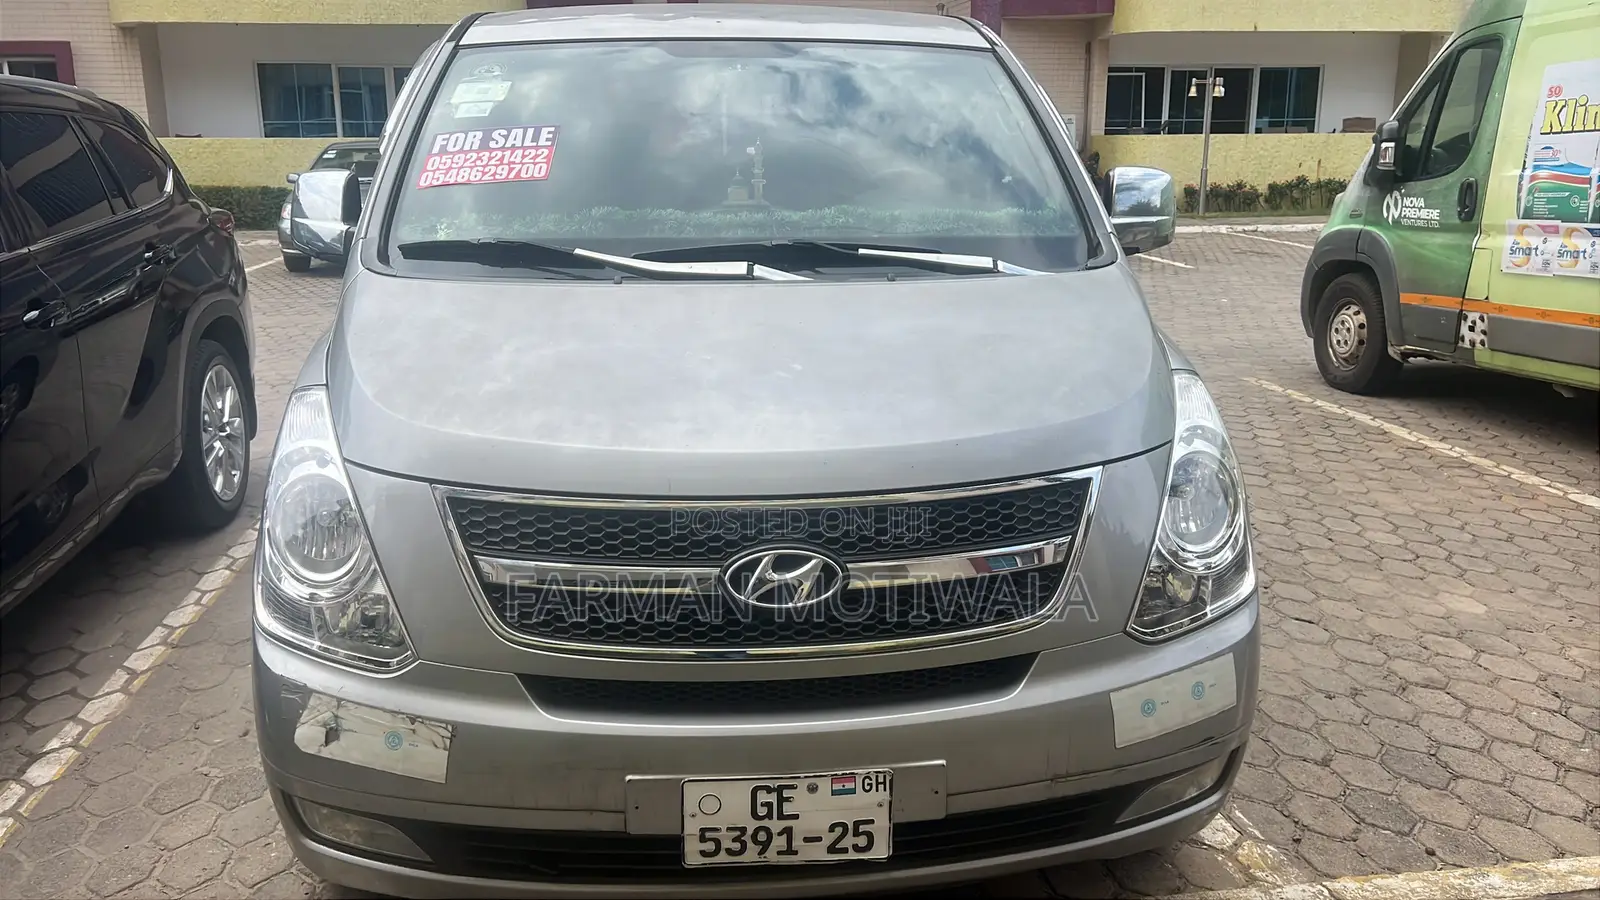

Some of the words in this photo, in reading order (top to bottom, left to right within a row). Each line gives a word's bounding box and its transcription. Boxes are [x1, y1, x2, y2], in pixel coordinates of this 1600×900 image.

[431, 131, 483, 154] FOR
[489, 127, 555, 149] SALE
[426, 148, 549, 171] 0592321422
[419, 163, 547, 187] 0548629700
[1401, 208, 1440, 220] PREMIERE
[1403, 197, 1425, 208] NOVA
[1401, 219, 1428, 227] VENTURES
[861, 775, 887, 793] GH
[750, 784, 800, 821] GE
[699, 818, 875, 858] 5391-25
